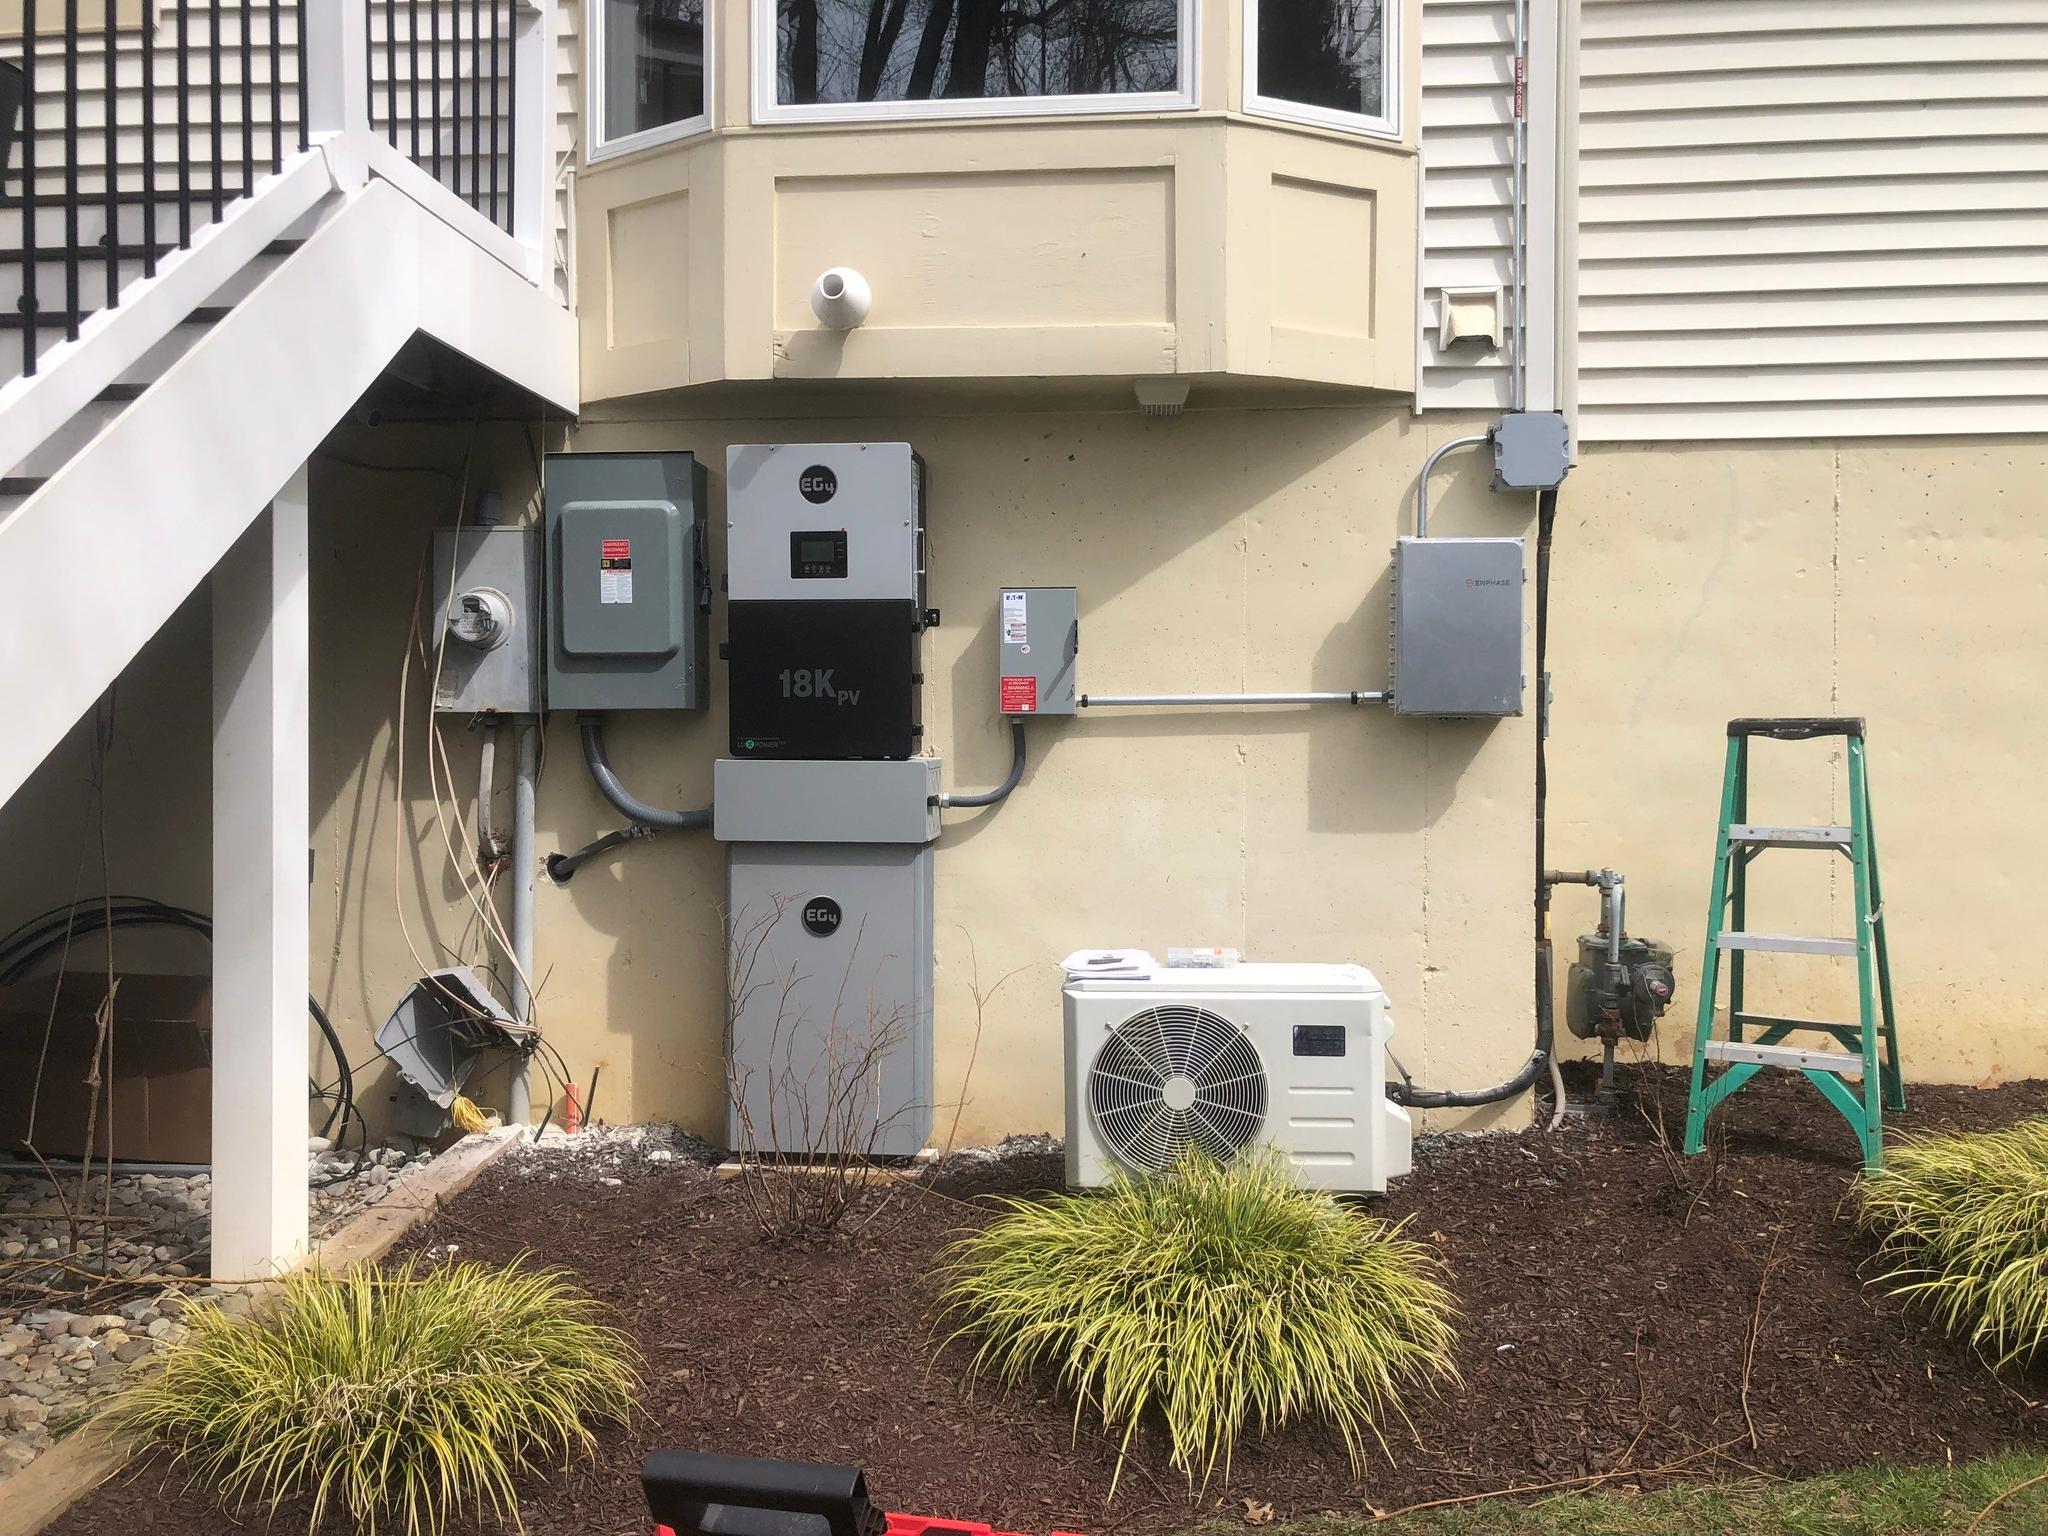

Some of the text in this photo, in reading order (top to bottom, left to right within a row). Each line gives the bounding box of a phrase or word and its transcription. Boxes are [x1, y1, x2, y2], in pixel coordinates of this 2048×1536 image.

[1516, 86, 1522, 94] DC
[801, 477, 834, 494] EG4
[806, 908, 838, 924] EG4
